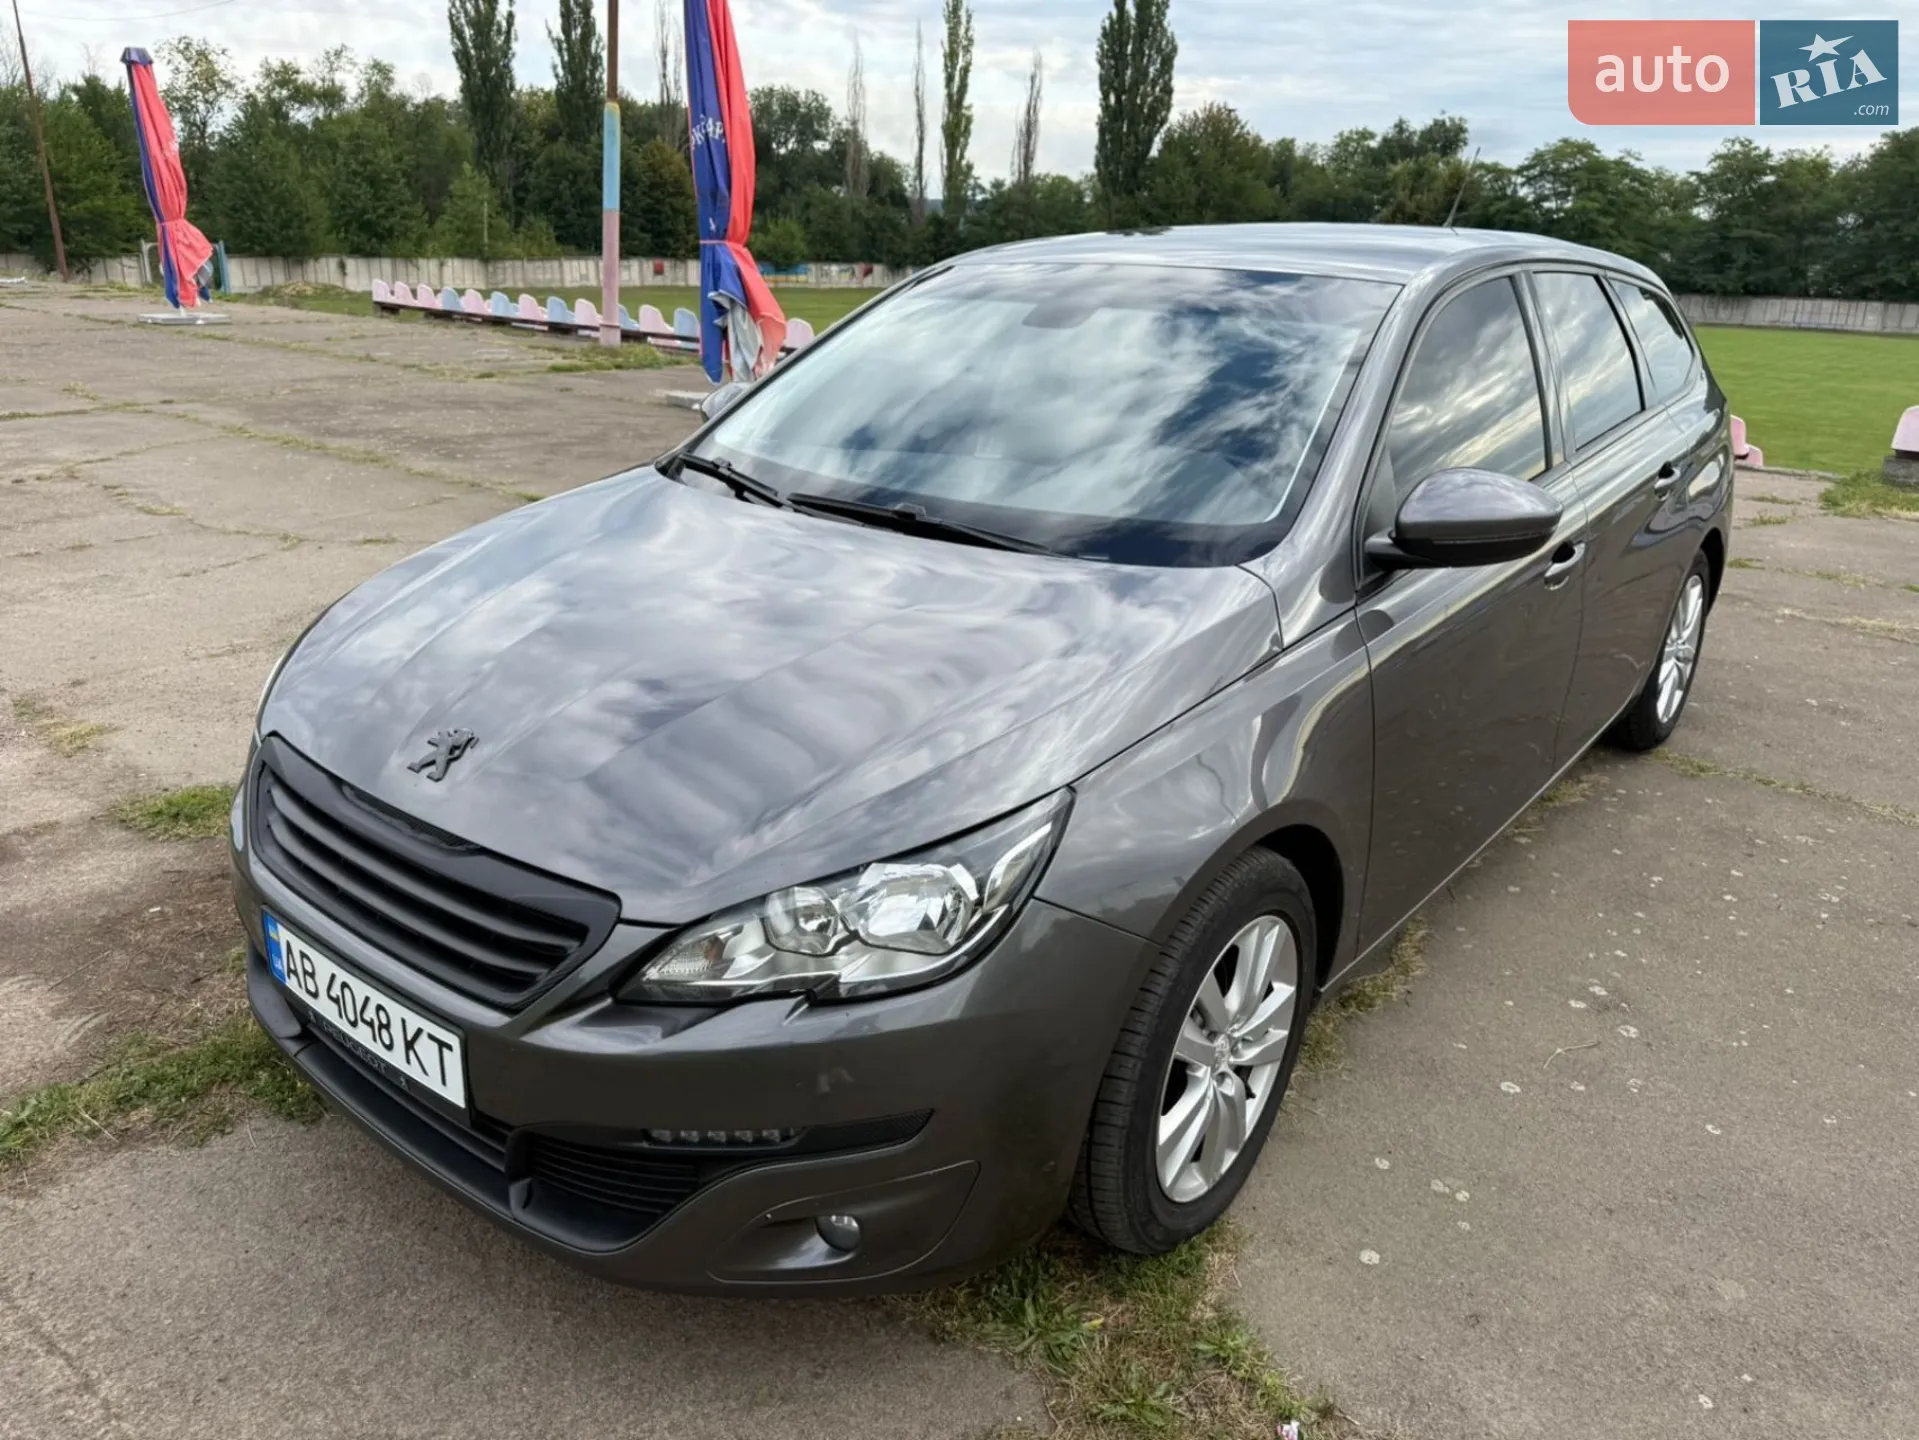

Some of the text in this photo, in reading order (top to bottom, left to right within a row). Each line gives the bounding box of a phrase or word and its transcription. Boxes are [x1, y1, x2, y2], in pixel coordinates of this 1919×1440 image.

[286, 940, 453, 1087] AB 4048 KT
